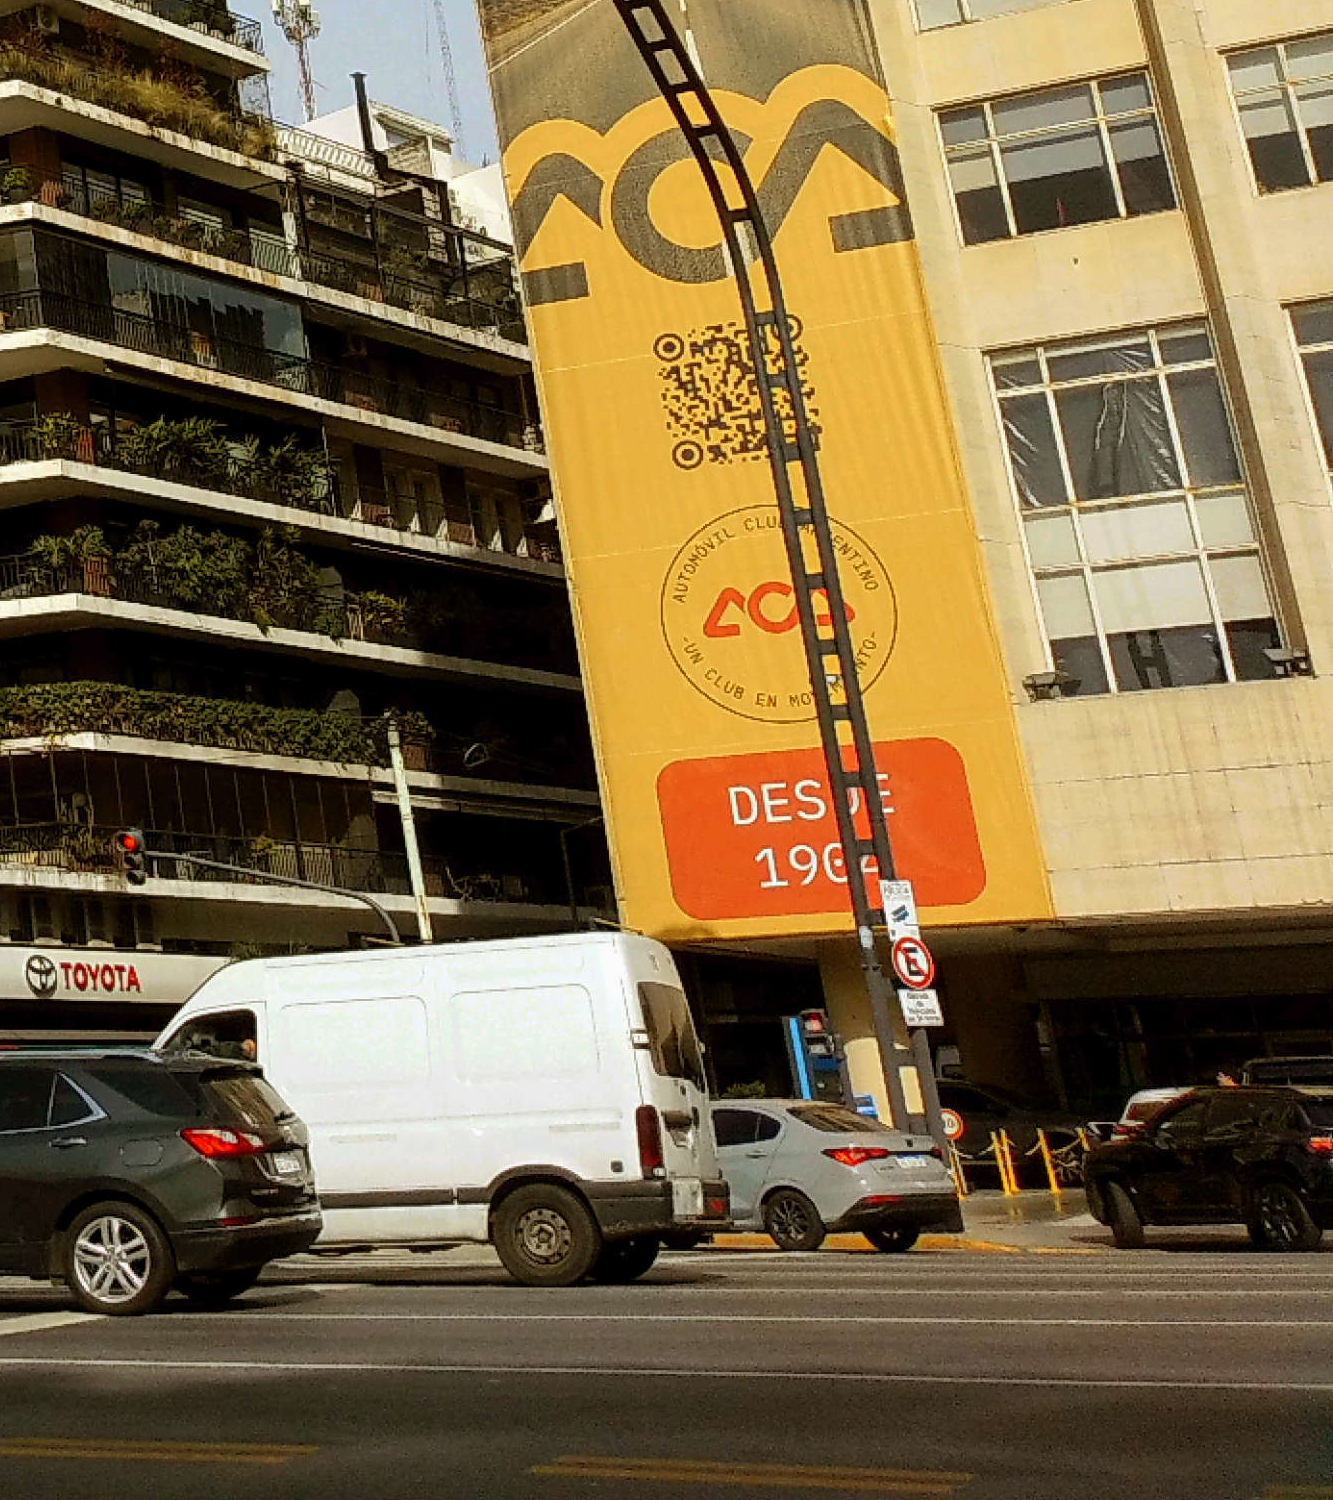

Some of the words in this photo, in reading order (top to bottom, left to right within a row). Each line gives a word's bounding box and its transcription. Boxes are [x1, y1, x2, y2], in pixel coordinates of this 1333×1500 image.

[673, 527, 735, 604] AUTOMÓVIL
[743, 516, 784, 531] CLU
[704, 667, 744, 700] CLUB
[755, 692, 777, 708] EN
[728, 773, 896, 826] DESE
[59, 961, 141, 994] TOYOTA
